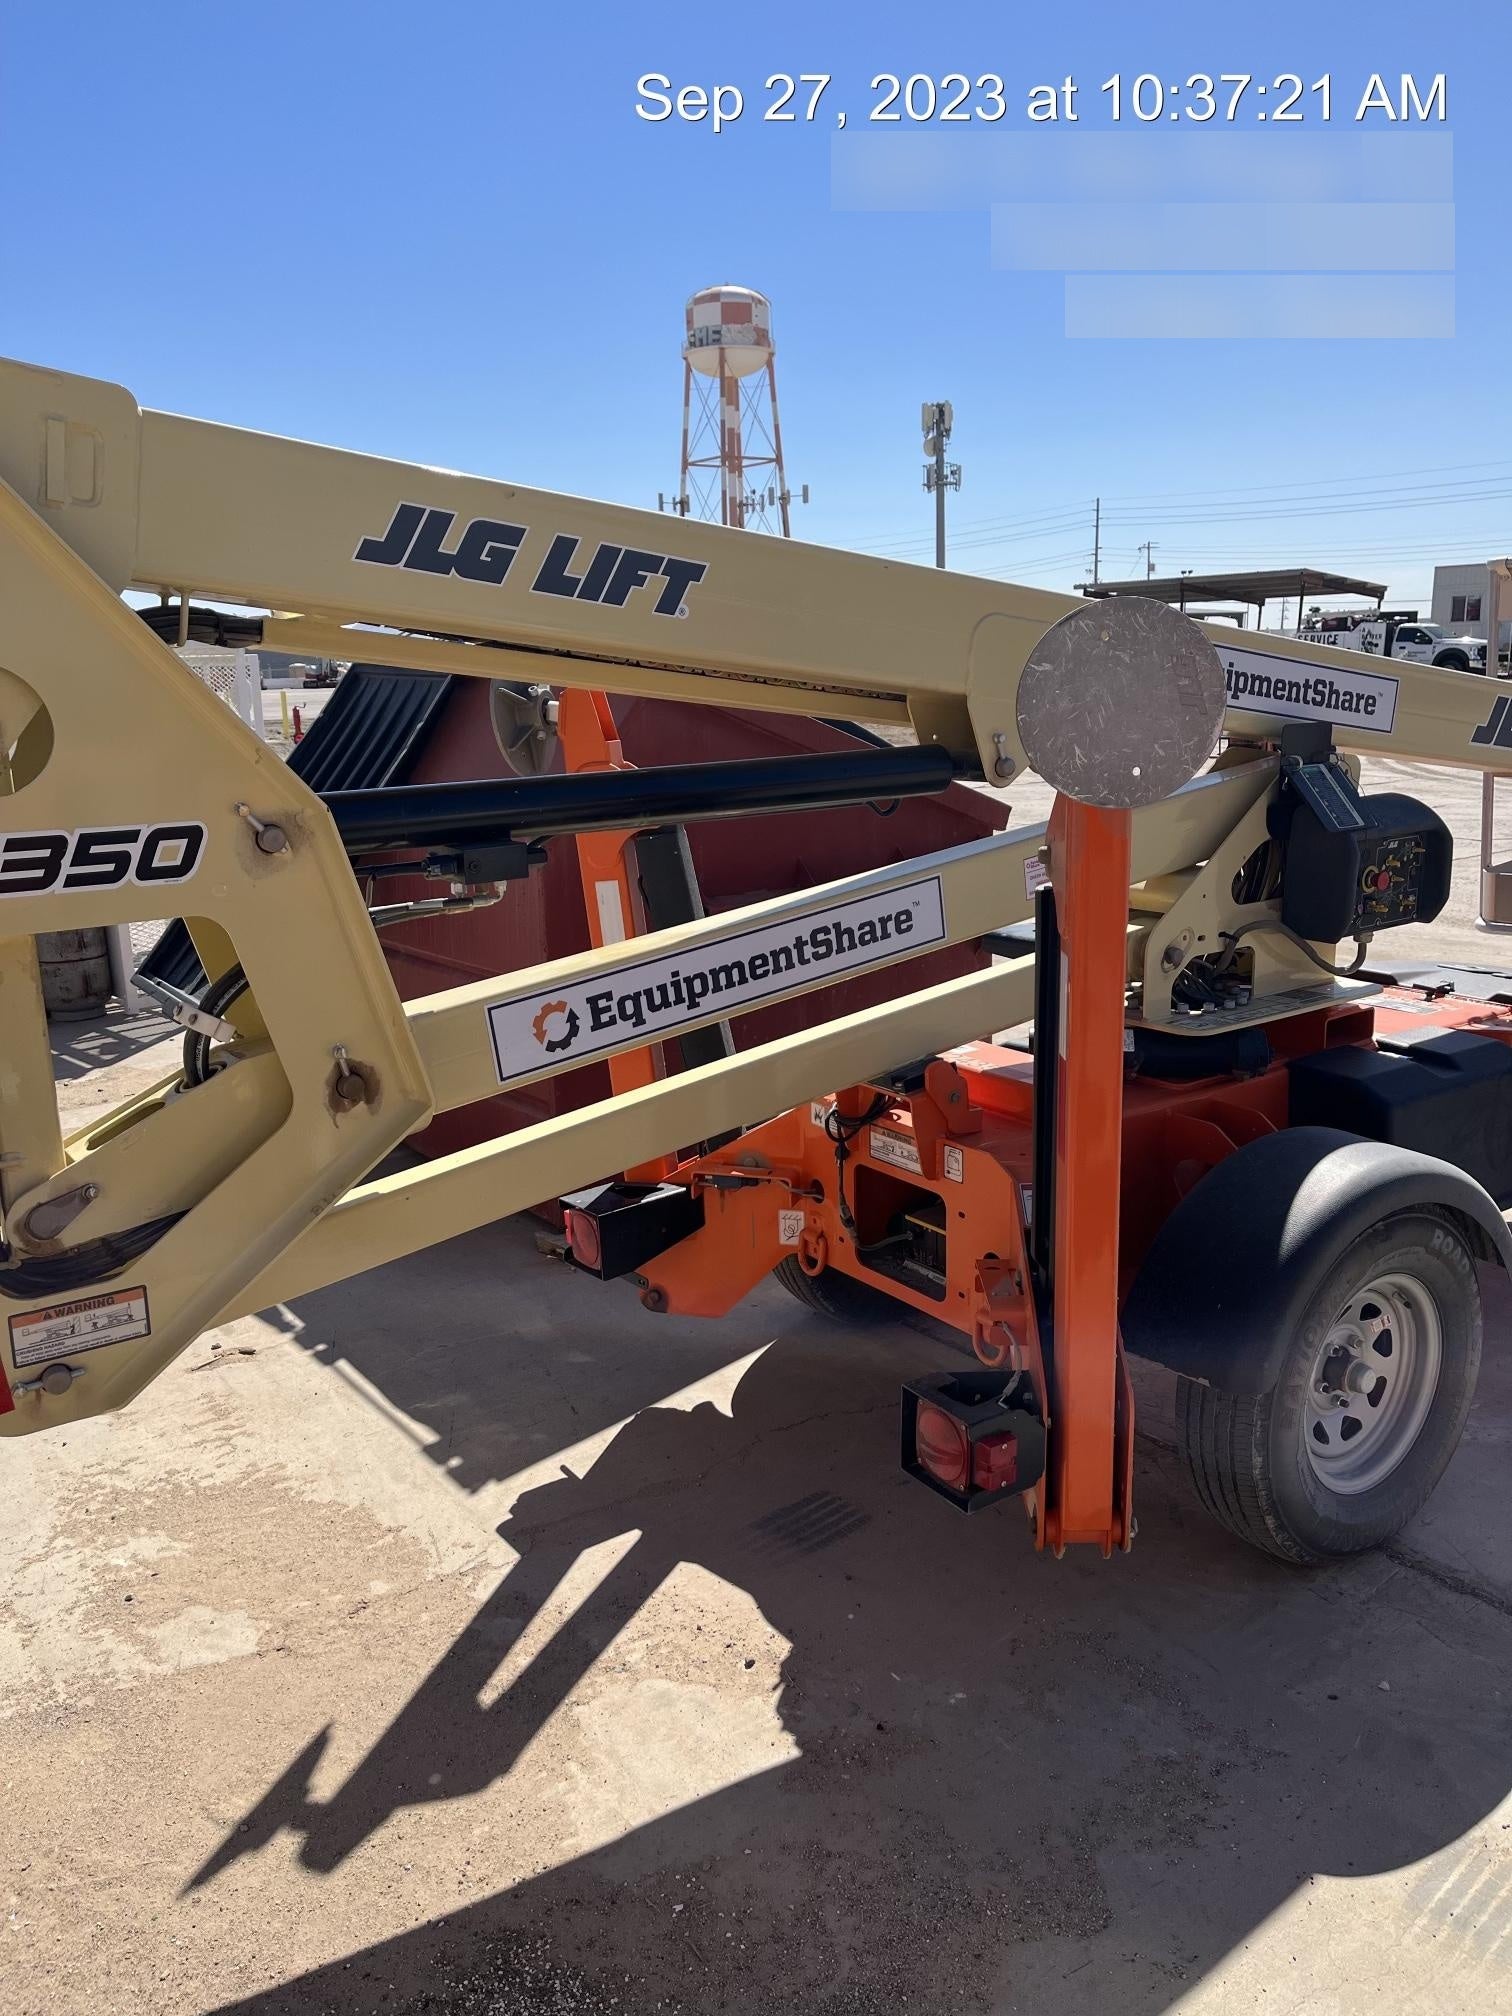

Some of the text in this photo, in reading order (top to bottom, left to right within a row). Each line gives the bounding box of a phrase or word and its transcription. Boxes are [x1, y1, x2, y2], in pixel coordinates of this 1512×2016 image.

[354, 503, 708, 616] JLG LIFT
[1222, 661, 1377, 716] ipmentShare
[0, 824, 204, 893] 350
[586, 908, 914, 1033] EquipmentShare
[52, 1296, 115, 1316] WARNING
